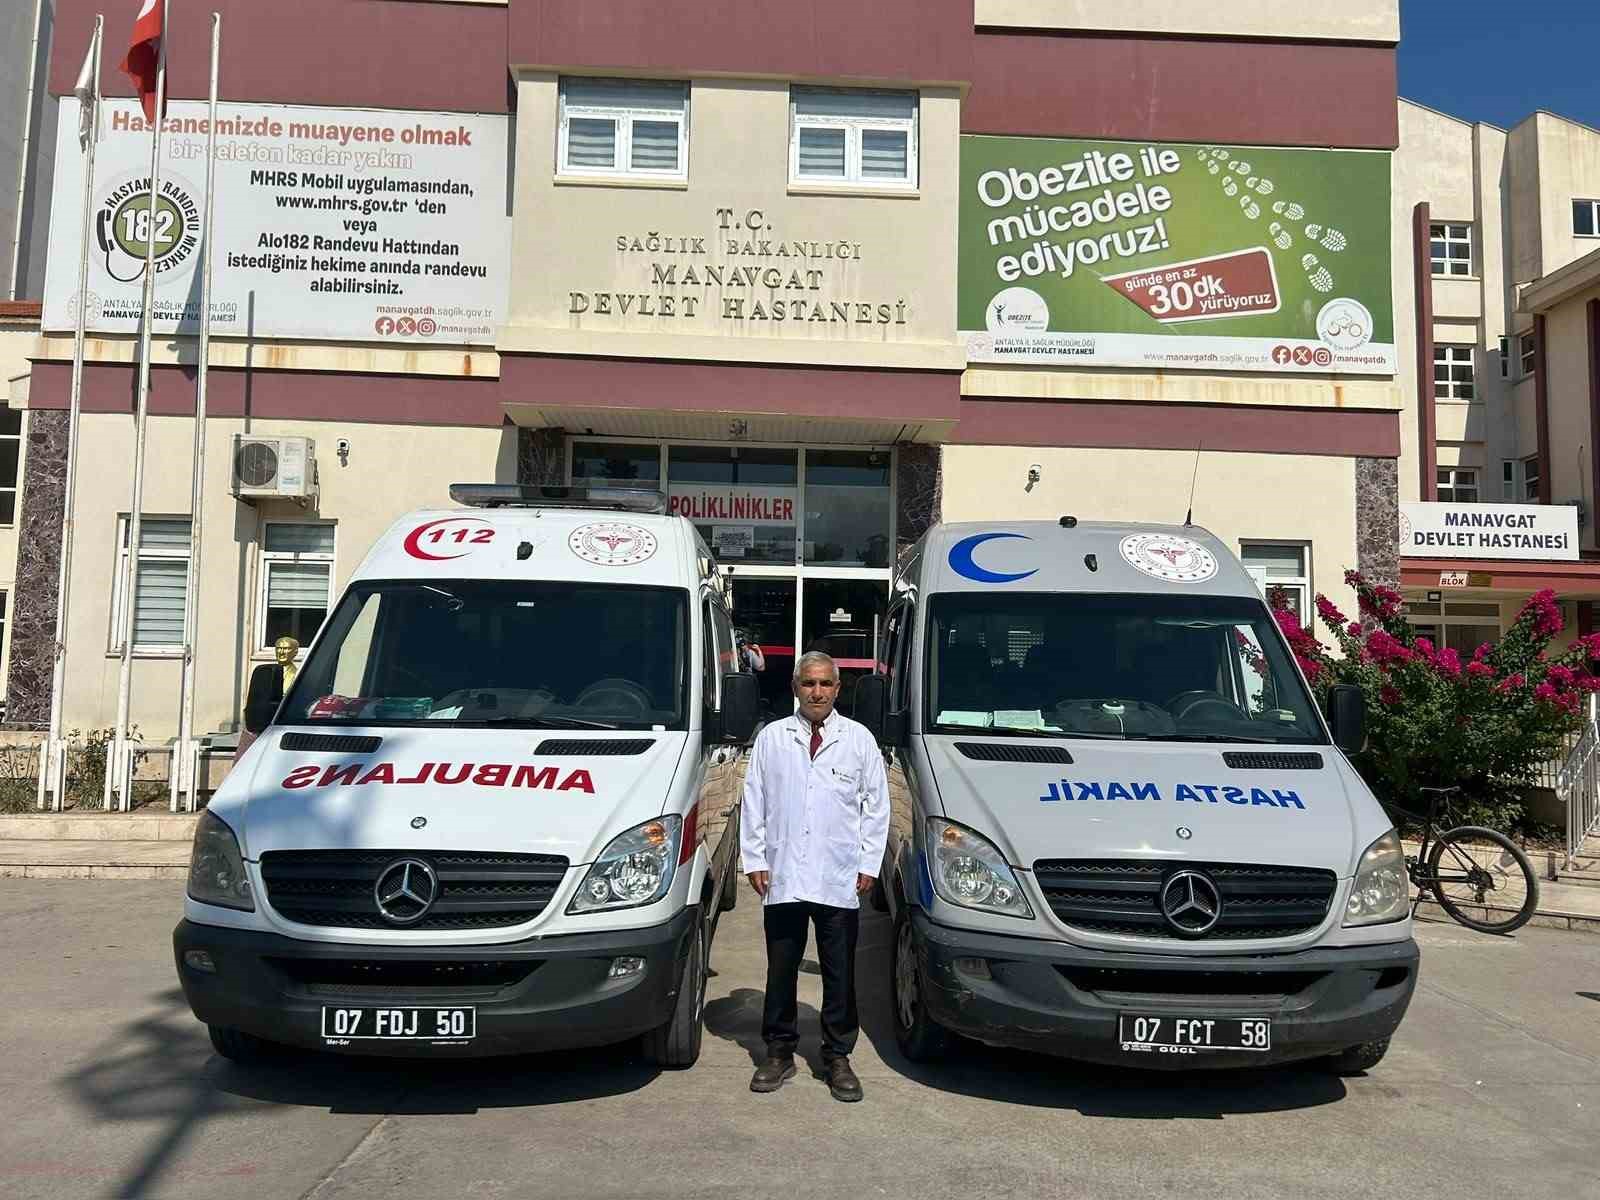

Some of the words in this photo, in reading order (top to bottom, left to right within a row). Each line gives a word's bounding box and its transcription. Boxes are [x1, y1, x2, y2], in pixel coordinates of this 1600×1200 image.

[289, 121, 394, 146] muayene
[400, 124, 471, 146] olmak
[169, 138, 202, 160] bir
[287, 143, 351, 166] kadar
[354, 147, 413, 172] yakın
[250, 170, 298, 187] MHRS
[301, 172, 343, 190] Mobil
[347, 176, 474, 198] uygulamasından,
[977, 150, 1134, 207] Obezite
[1139, 147, 1181, 177] ile
[105, 178, 153, 208] HASTAN
[275, 195, 408, 215] www.mhrs.gov.tr
[162, 181, 199, 231] RANDEVU
[987, 183, 1172, 246] mücadele
[121, 208, 175, 243] 182
[343, 219, 377, 235] veya
[716, 208, 773, 231] T.C.
[154, 235, 197, 273] MERKEZ
[257, 232, 310, 249] Alo182
[313, 235, 379, 252] Randevu
[382, 237, 459, 256] Hattından
[616, 231, 706, 254] SAĞLIK
[726, 239, 862, 260] BAKANLIĞI
[997, 217, 1170, 282] ediyoruz!
[227, 252, 308, 273] istediğiniz
[311, 256, 366, 272] hekime
[370, 260, 421, 275] anında
[424, 261, 487, 277] randevu
[651, 263, 824, 290] MANAVGAT
[309, 277, 403, 295] alabilirsiniz.
[1125, 272, 1162, 292] günde
[1165, 271, 1181, 282] en
[1183, 267, 1198, 280] az
[102, 310, 144, 320] MANAVGA
[153, 311, 185, 321] DEVLET
[103, 299, 143, 309] ANTALYA
[569, 292, 699, 318] DEVLET
[722, 298, 907, 325] HASTANESİ
[1200, 293, 1272, 313] yürüyoruz
[994, 346, 1031, 354] MANAVGAT
[671, 492, 793, 520] POLİKLİNİKLER
[1445, 513, 1536, 528] MANAVGAT
[427, 528, 495, 544] 112
[1414, 531, 1475, 547] DEVLET
[1479, 532, 1568, 549] HASTANESİ
[335, 1009, 362, 1035] 07
[375, 1010, 418, 1035] FDJ
[436, 1010, 465, 1035] 50
[1134, 1017, 1161, 1042] 07
[1175, 1019, 1215, 1045] FCT
[1240, 1022, 1267, 1047] 58
